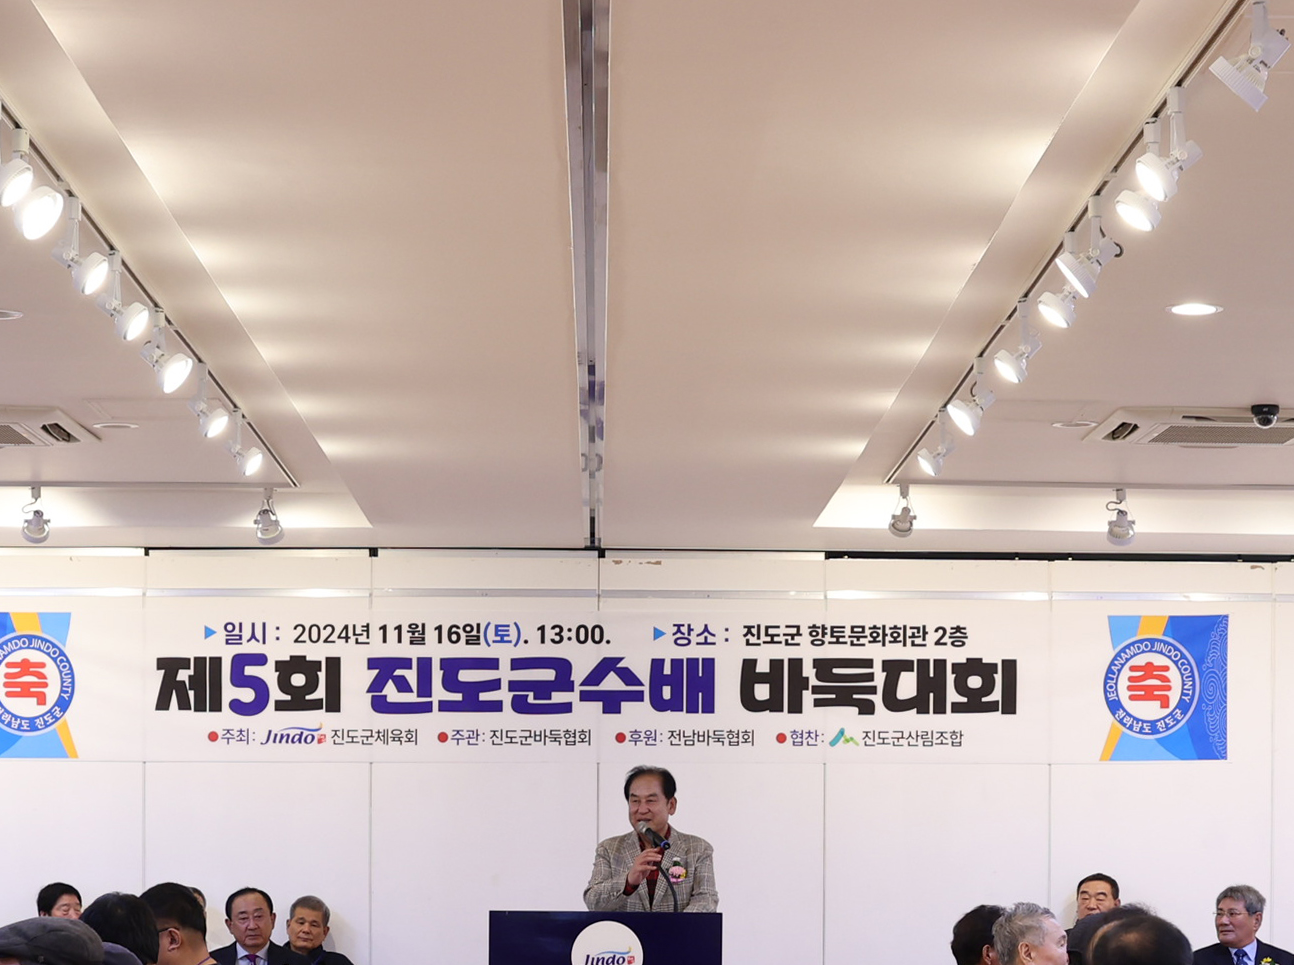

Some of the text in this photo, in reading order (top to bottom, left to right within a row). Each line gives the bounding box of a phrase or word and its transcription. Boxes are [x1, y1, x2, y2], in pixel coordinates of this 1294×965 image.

[224, 622, 266, 645] 일시
[294, 623, 370, 644] 2024년
[379, 623, 426, 645] 11월
[537, 624, 610, 644] 13:00.
[672, 624, 716, 647] 장소
[743, 624, 802, 646] 진도군
[808, 624, 928, 647] 향토문화회관
[934, 625, 968, 647] 2층
[3, 658, 48, 706] 축
[30, 639, 60, 658] JINDO
[57, 656, 72, 700] COUNTY
[155, 653, 1017, 716] 제5회 진도군수배 바둑대회
[1106, 641, 1193, 703] JEOLLANAMDO JINDO COUNTY
[1126, 661, 1172, 709] 축
[35, 706, 63, 729] 진도군
[221, 729, 255, 745] 주최:
[260, 728, 314, 745] Jindo
[331, 729, 417, 745] 진도군체육회
[451, 729, 485, 745] 주관:
[490, 729, 591, 746] 진도군바둑협회
[629, 729, 662, 746] 후원:
[668, 730, 754, 746] 전남바둑협회
[791, 730, 824, 746] 협찬:
[863, 730, 963, 747] 진도군산림조합
[1115, 708, 1185, 733] 전라남도 진도군
